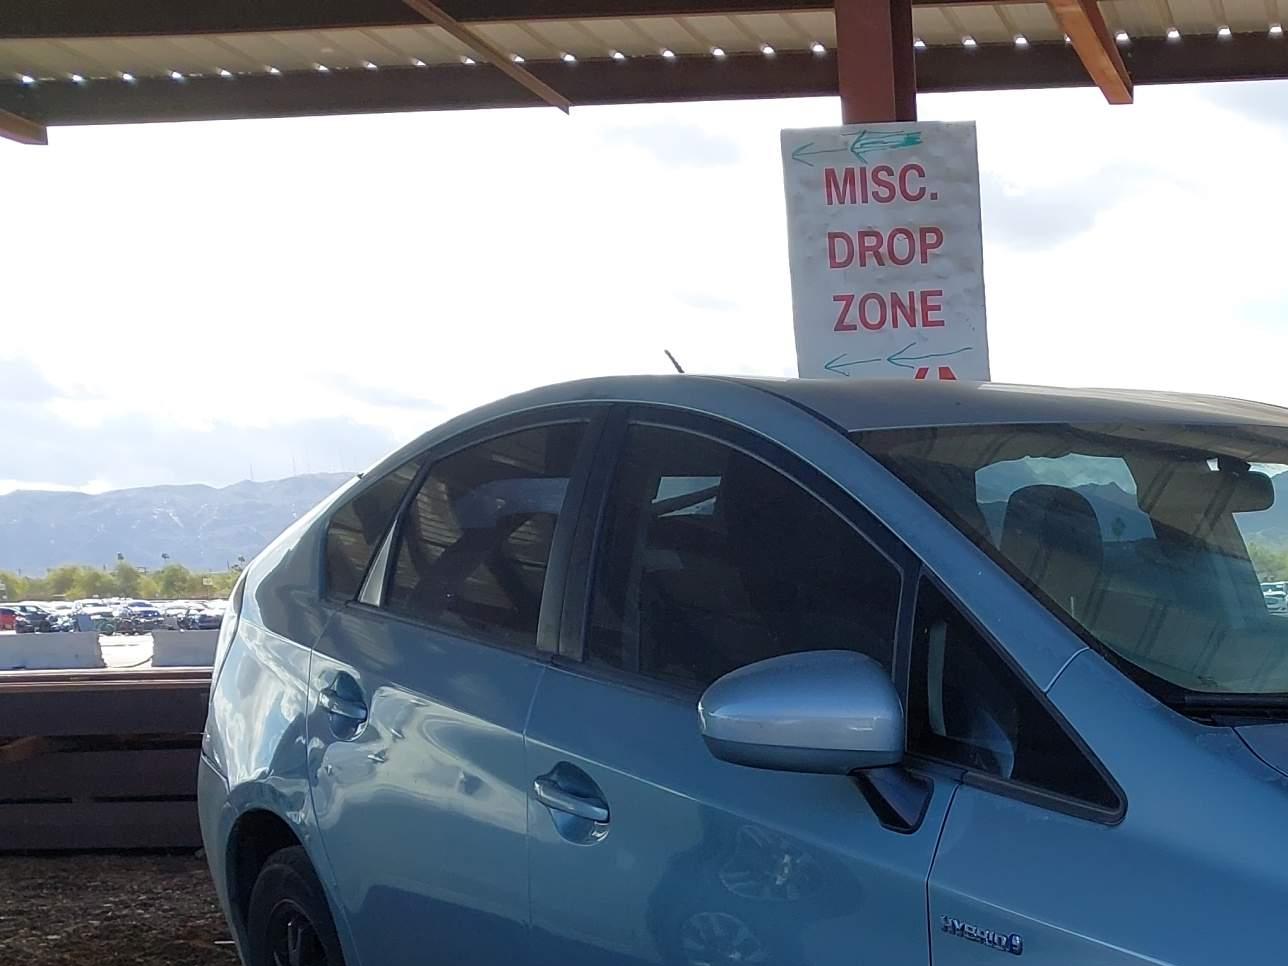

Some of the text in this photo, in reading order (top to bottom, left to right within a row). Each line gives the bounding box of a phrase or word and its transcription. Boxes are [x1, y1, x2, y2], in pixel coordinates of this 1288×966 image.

[824, 164, 938, 205] MISC.
[827, 226, 943, 269] DROP
[832, 290, 945, 332] ZONE
[940, 914, 1009, 952] HYBRID
